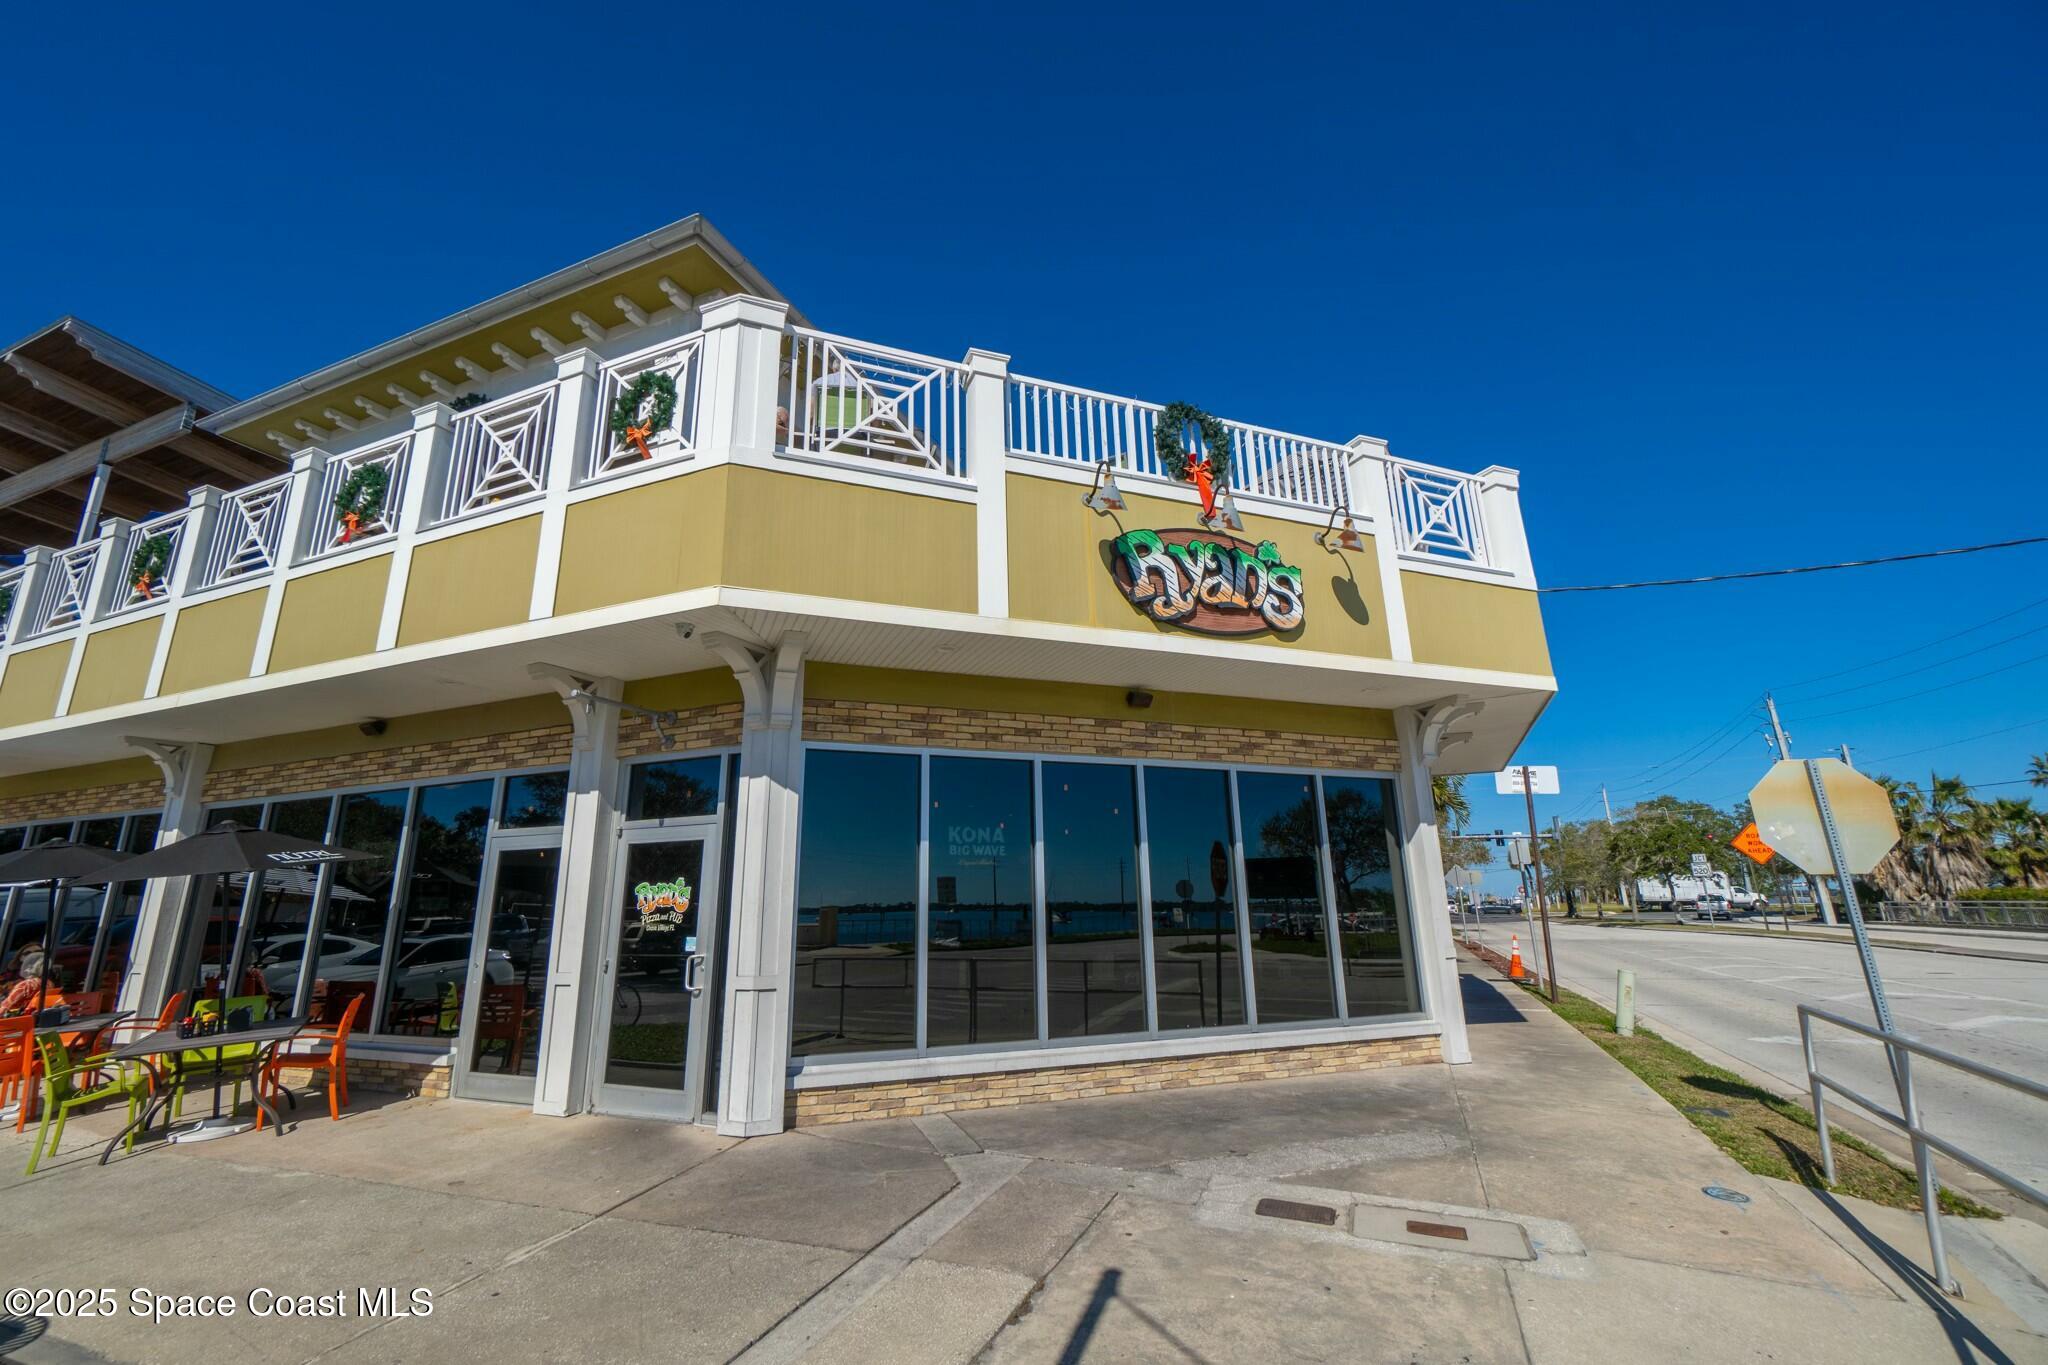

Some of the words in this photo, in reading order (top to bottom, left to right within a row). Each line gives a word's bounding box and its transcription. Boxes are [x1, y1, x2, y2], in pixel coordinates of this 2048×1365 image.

[947, 825, 1005, 844] KONA
[949, 844, 970, 856] BIG
[972, 844, 1007, 856] WAVE
[1694, 867, 1709, 875] 520
[640, 912, 660, 925] Pizza
[669, 911, 684, 924] PUB
